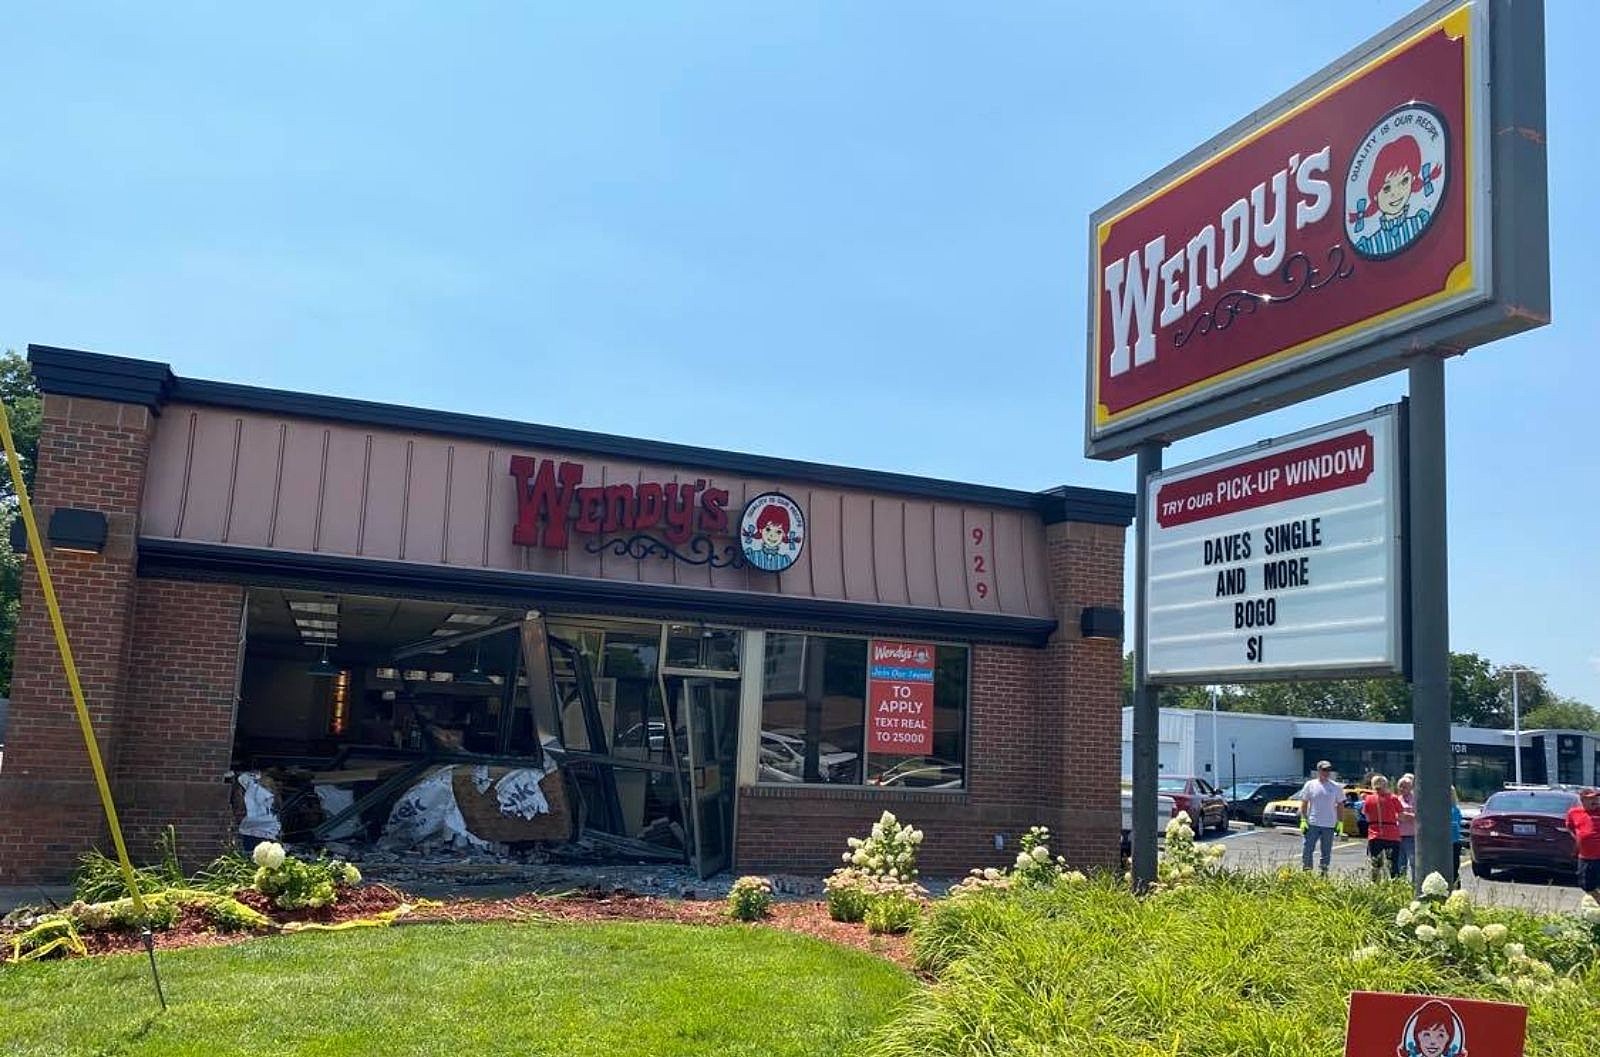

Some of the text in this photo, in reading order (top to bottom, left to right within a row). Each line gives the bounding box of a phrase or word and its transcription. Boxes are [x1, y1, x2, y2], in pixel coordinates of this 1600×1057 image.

[1351, 114, 1439, 182] QUALITY IS OUR RECIPE
[1162, 444, 1366, 516] TRY OUR PICK-UP WINDOW
[1203, 517, 1322, 566] DAVES SINGLE
[1216, 557, 1309, 597] AND MORE
[1234, 598, 1276, 629] BOGO
[874, 645, 912, 662] Wendy's
[892, 686, 911, 698] TO
[879, 700, 923, 714] APPLY
[875, 717, 927, 729] TEXT REAL
[876, 732, 924, 743] TO 25000
